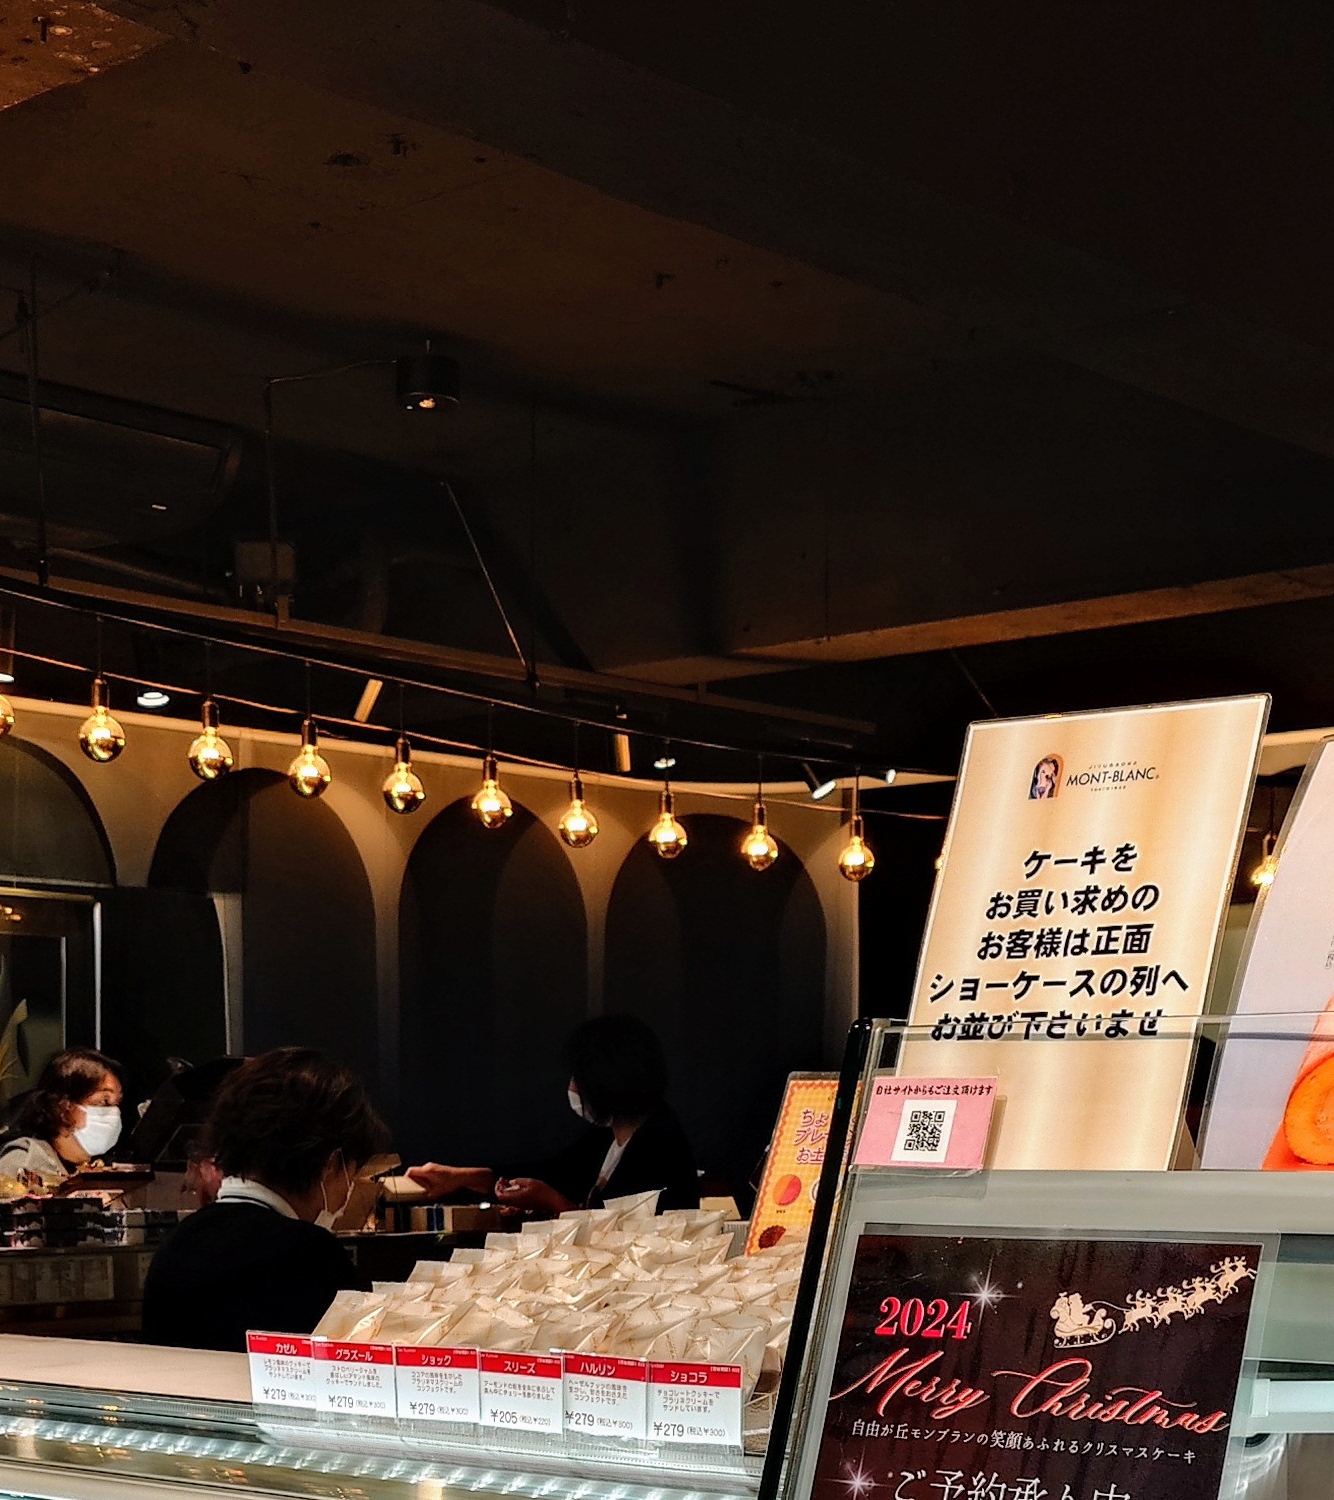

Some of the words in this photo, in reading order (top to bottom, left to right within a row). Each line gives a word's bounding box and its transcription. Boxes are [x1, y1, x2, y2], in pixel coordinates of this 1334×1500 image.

[1066, 767, 1156, 787] MONT-BLANC
[1024, 843, 1138, 879] ケーキを
[986, 885, 1159, 919] お買い求めの
[977, 923, 1154, 960] お客様は正面
[929, 965, 1189, 1002] ショーケースの列へ
[931, 1009, 1167, 1041] お並び下さいませ
[876, 1084, 993, 1096] 自社サイトからもご注文頂けます
[875, 1296, 972, 1340] 2024
[503, 1360, 536, 1374] スリーズ
[670, 1370, 708, 1384] ショコラ
[263, 1387, 287, 1400] ¥279
[828, 1347, 992, 1418] Merry
[991, 1358, 1230, 1435] Christmas
[328, 1395, 354, 1408] ¥279
[409, 1402, 435, 1415] ¥279
[490, 1409, 517, 1424] ¥205
[565, 1411, 594, 1426] ¥279
[653, 1422, 684, 1437] ¥279
[851, 1418, 1197, 1465] 自由が丘モンブランの笑顔あふれるクリスマスケーキ
